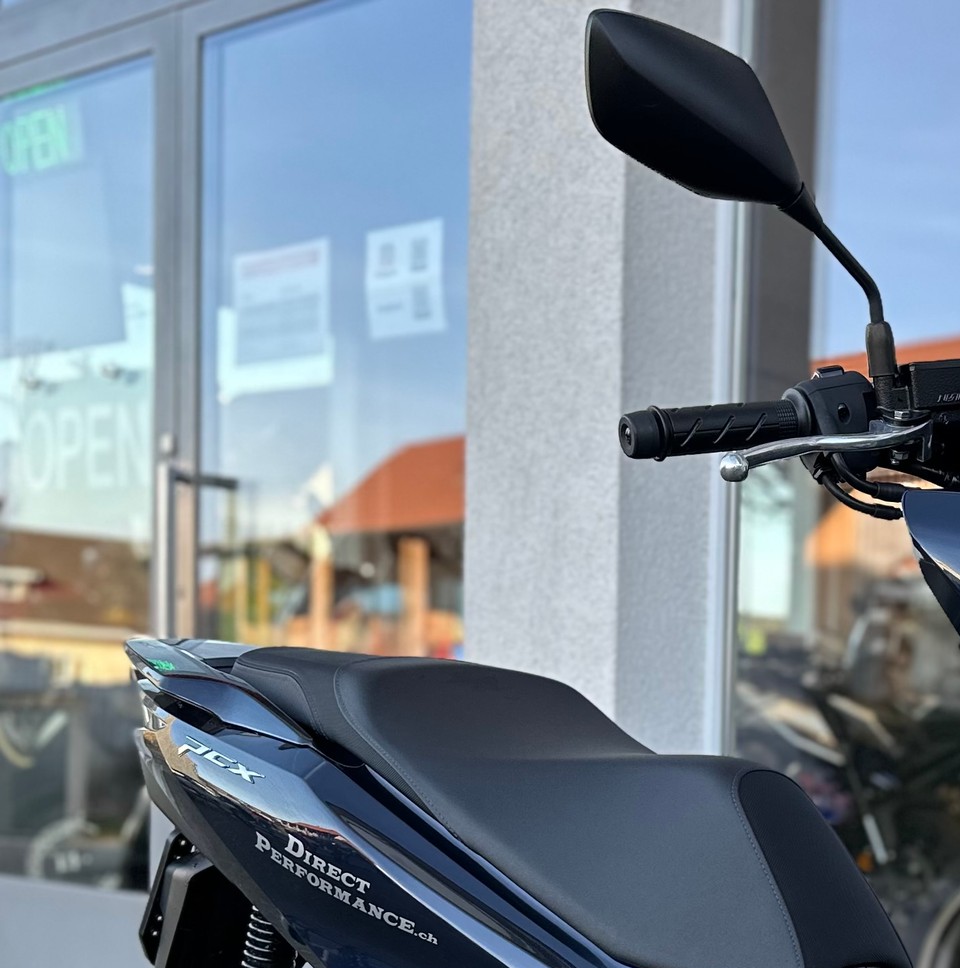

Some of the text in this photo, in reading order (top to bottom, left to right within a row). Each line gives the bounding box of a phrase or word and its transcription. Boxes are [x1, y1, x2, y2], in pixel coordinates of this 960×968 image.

[23, 403, 152, 492] OPEN
[178, 735, 266, 784] PCX
[254, 831, 439, 946] PERFORMANCE.ch
[284, 833, 370, 894] DIRECT
